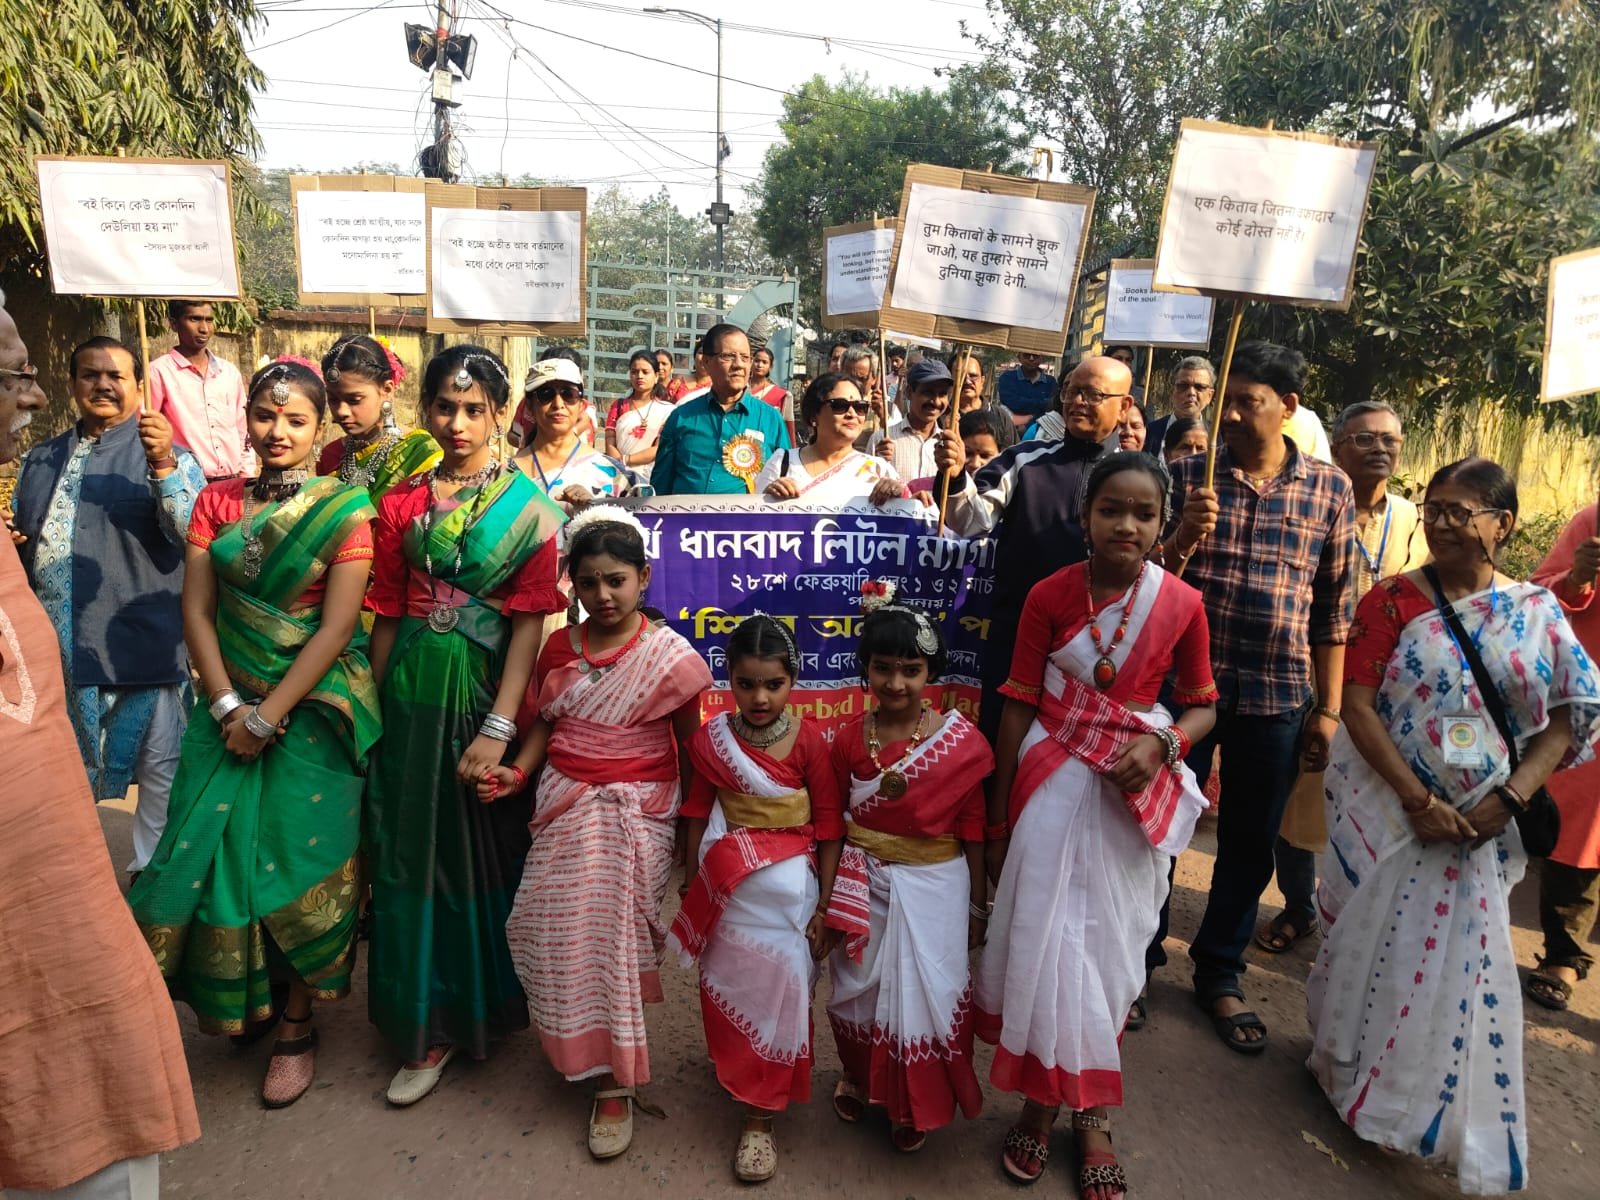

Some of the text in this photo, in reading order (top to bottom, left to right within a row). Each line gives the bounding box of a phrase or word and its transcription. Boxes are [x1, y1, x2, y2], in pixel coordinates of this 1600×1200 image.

[101, 197, 125, 211] কিনে
[129, 199, 150, 211] কেউ
[154, 198, 196, 211] কোনদিন
[1194, 197, 1217, 210] एक
[1261, 200, 1295, 217] जितना
[1216, 218, 1242, 237] कोई
[1244, 220, 1275, 238] दोस्त
[488, 238, 511, 249] অতীত
[514, 241, 529, 250] আর
[923, 223, 1060, 255] तुम किताबों के सामने झुक
[927, 243, 1049, 271] जाओ, यह तुम्हारे सामने
[939, 264, 1027, 289] दुनिया झुका देगी.
[680, 527, 805, 561] ধানবাদ
[811, 516, 910, 566] লিটল
[917, 535, 999, 572] ম্যাগা
[731, 572, 788, 592] ২৮শে
[914, 576, 922, 593] ১
[931, 577, 945, 593] ও
[948, 578, 959, 594] ২
[826, 651, 857, 672] এবং
